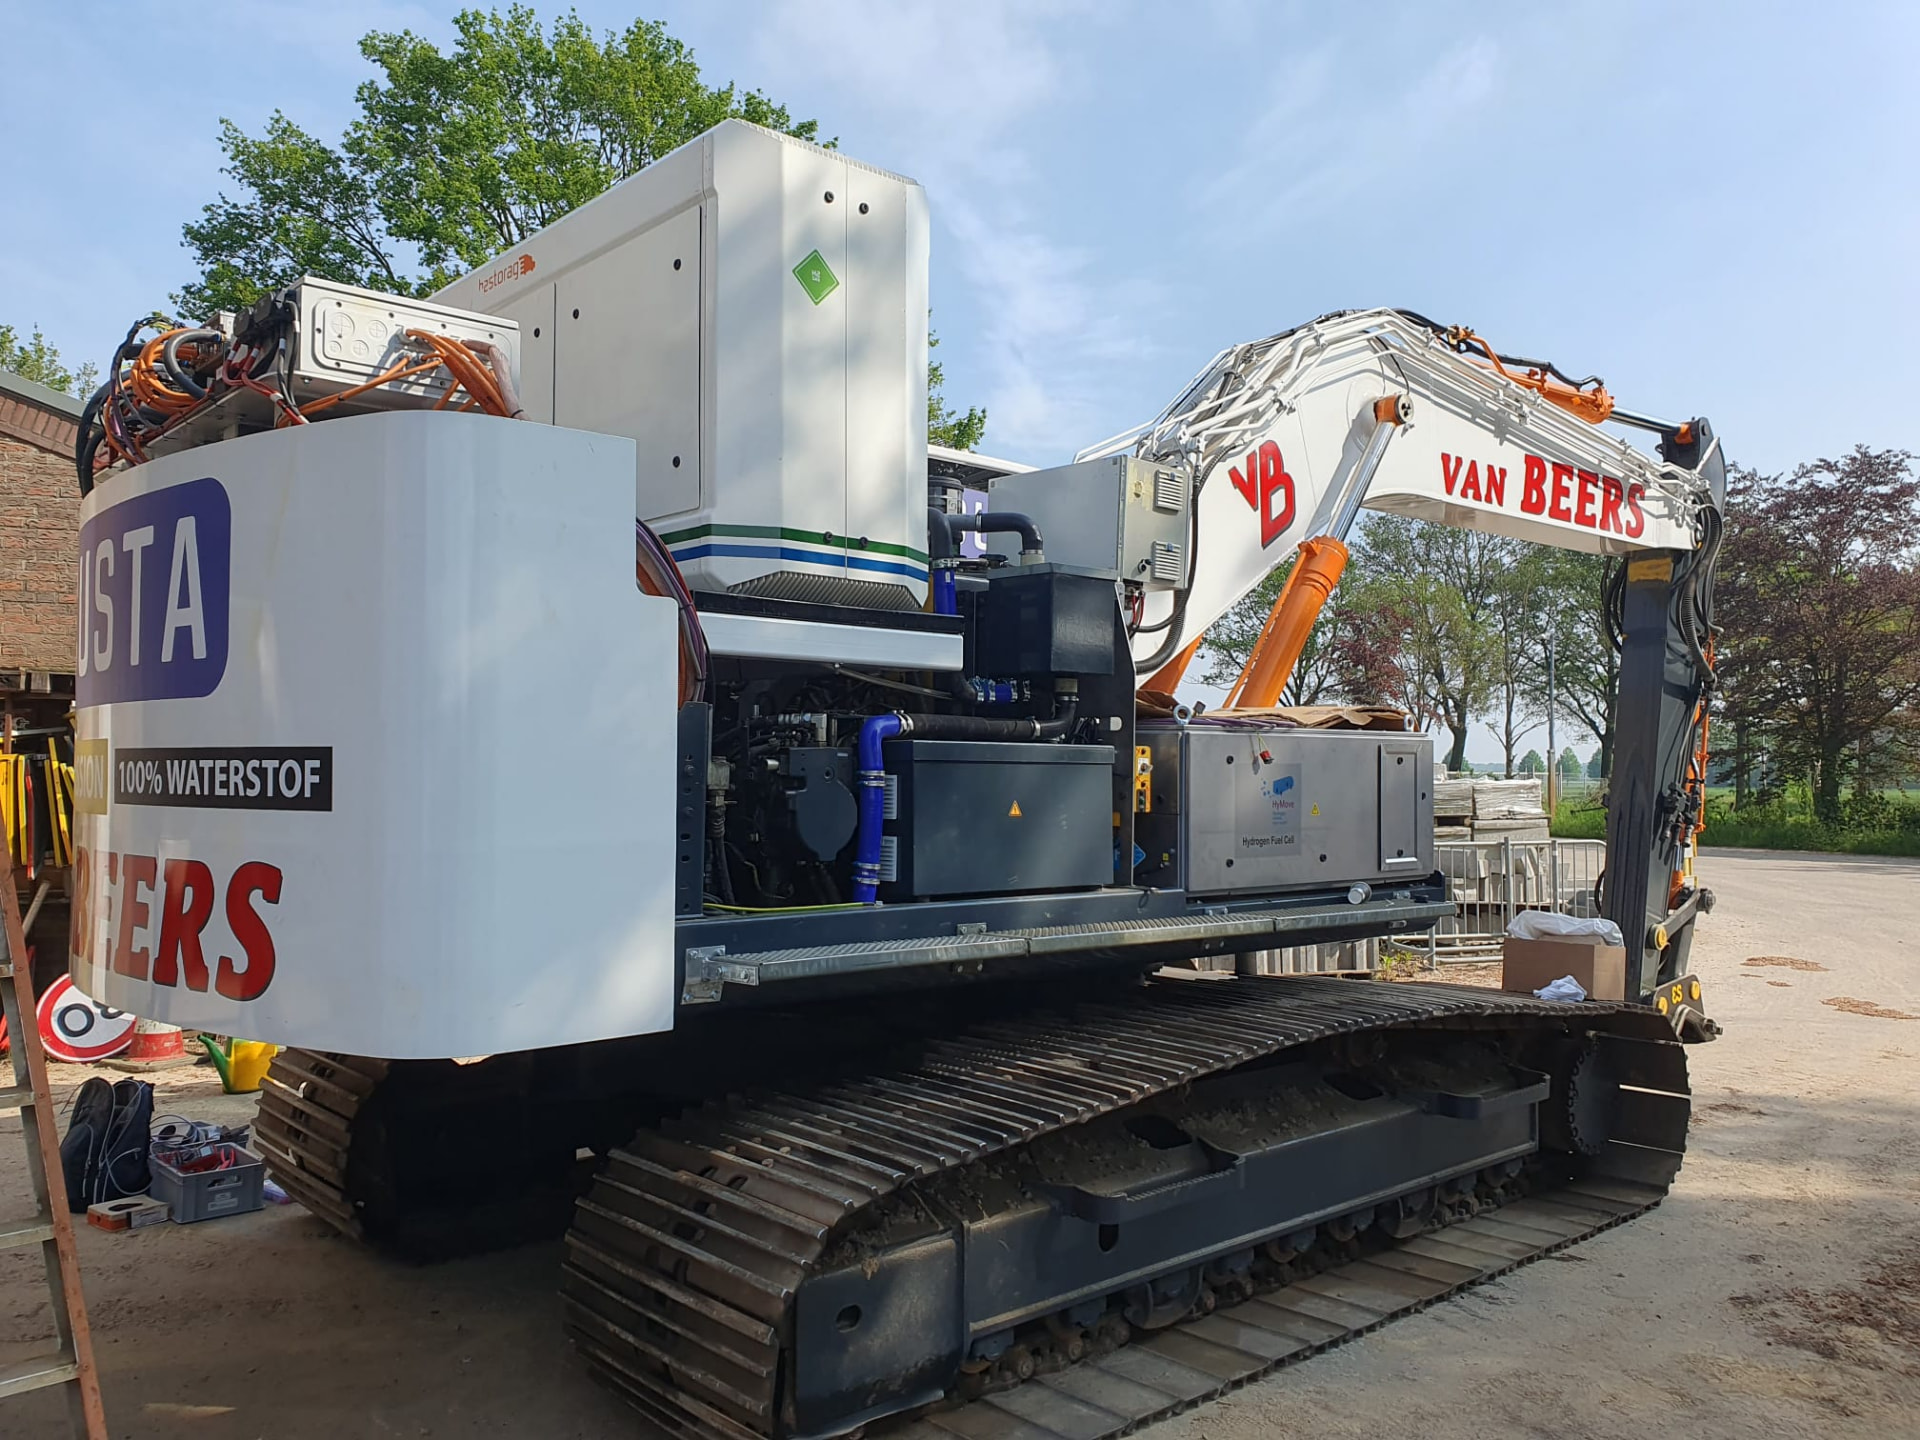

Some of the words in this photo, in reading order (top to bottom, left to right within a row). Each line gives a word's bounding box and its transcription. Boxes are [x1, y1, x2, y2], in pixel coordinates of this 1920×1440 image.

[1228, 440, 1296, 550] VB
[1441, 453, 1507, 507] VAN
[1521, 453, 1646, 539] BEERS
[119, 760, 162, 795] 100%
[166, 759, 321, 799] WATERSTOF
[1272, 799, 1295, 810] HyMove
[1242, 836, 1270, 848] Hydrogen
[1271, 835, 1283, 846] Fuel
[1284, 834, 1295, 845] Cell
[72, 845, 284, 1002] BEERS
